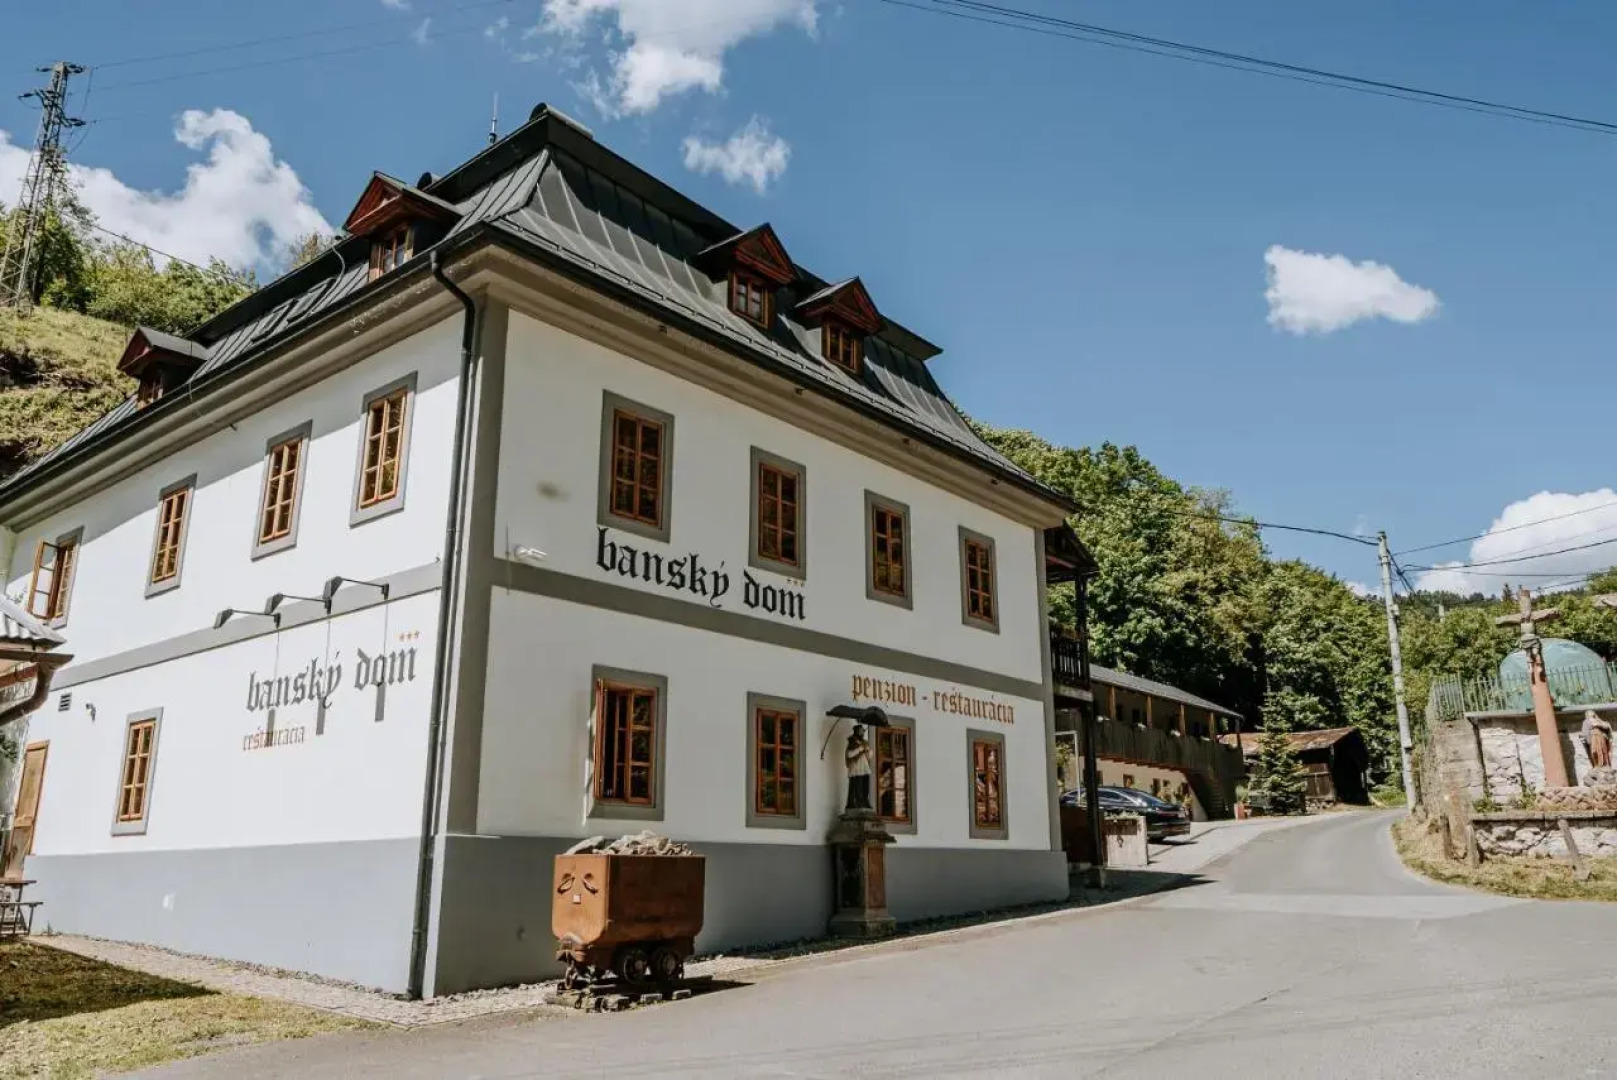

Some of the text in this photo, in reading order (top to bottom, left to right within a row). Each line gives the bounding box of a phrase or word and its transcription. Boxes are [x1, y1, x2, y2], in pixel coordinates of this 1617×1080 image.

[596, 526, 806, 621] banský dom
[246, 647, 417, 710] banský dom
[852, 673, 917, 707] penzion
